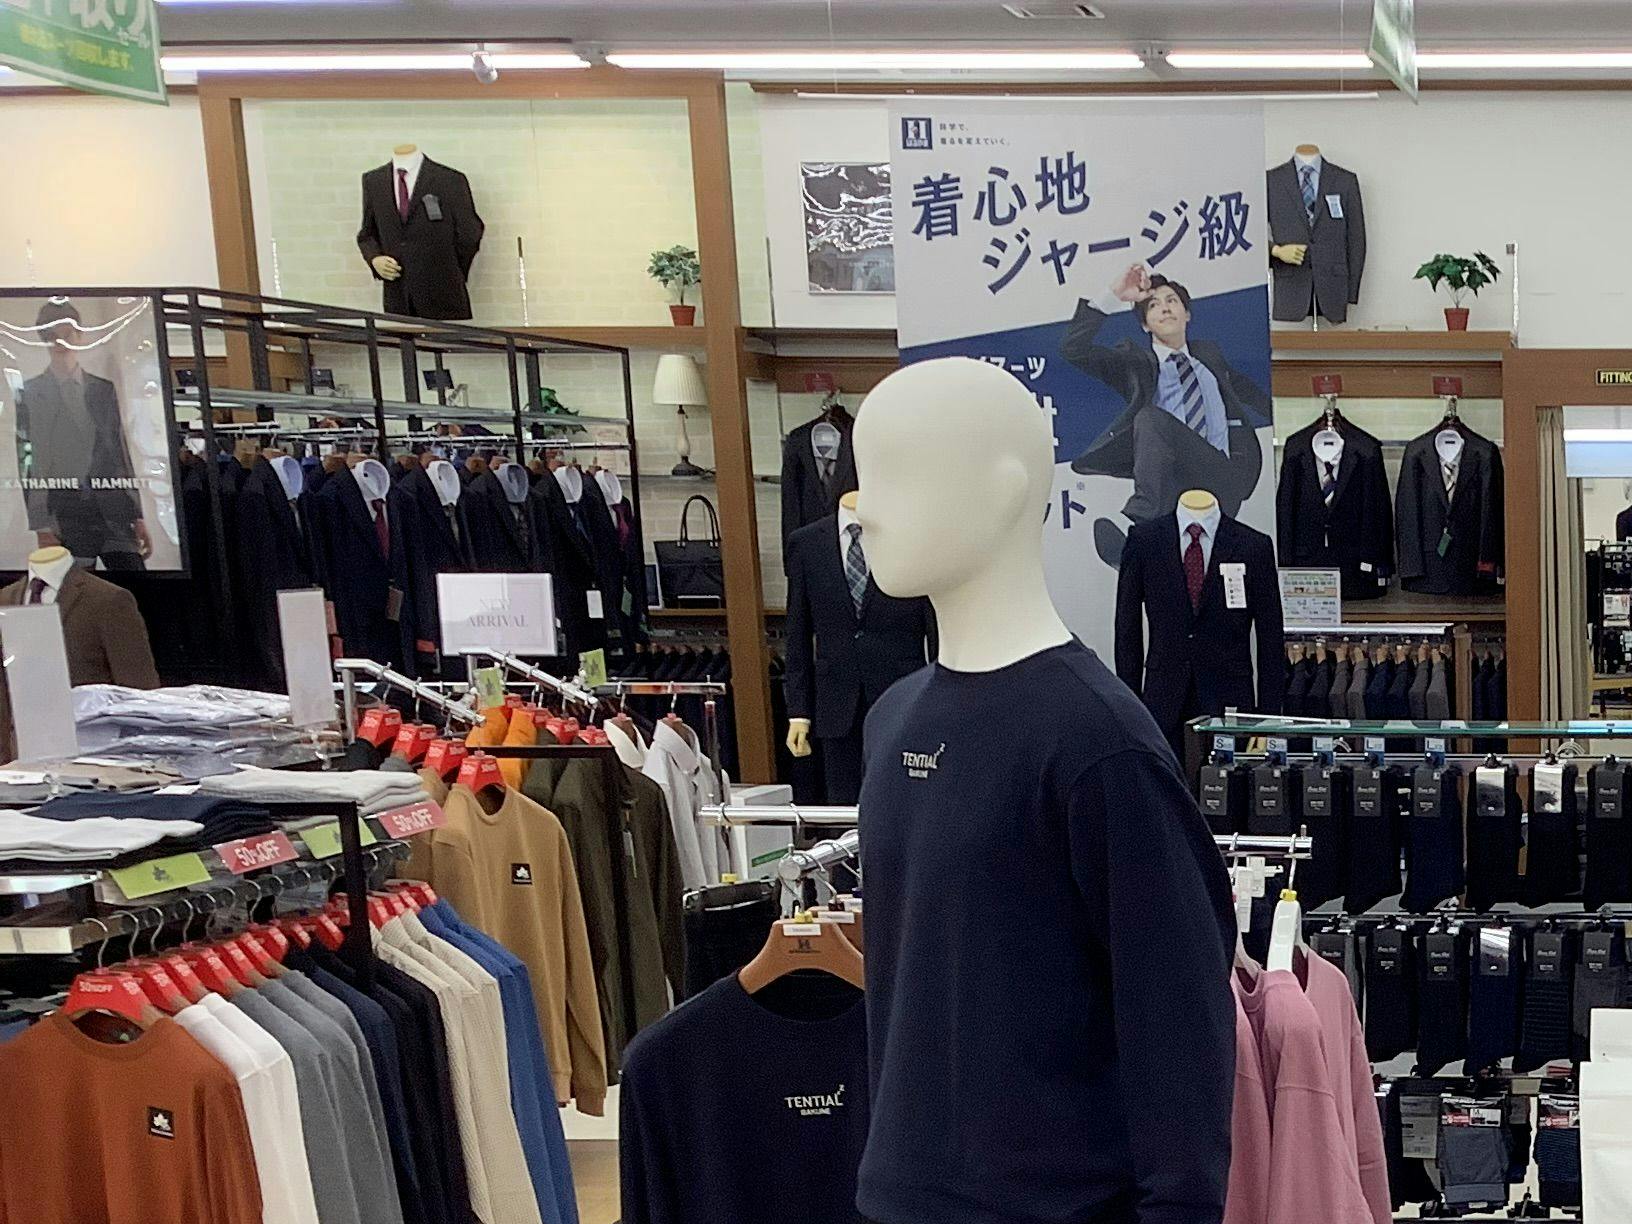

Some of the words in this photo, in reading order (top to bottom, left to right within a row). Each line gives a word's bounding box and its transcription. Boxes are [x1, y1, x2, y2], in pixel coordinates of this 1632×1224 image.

[912, 151, 1090, 241] 着心地
[983, 191, 1252, 295] ジャージ級
[468, 614, 528, 627] ARRIVAL
[392, 810, 434, 832] 50%OFF
[235, 841, 280, 867] 50%OFF
[784, 1093, 844, 1108] TENTIAL
